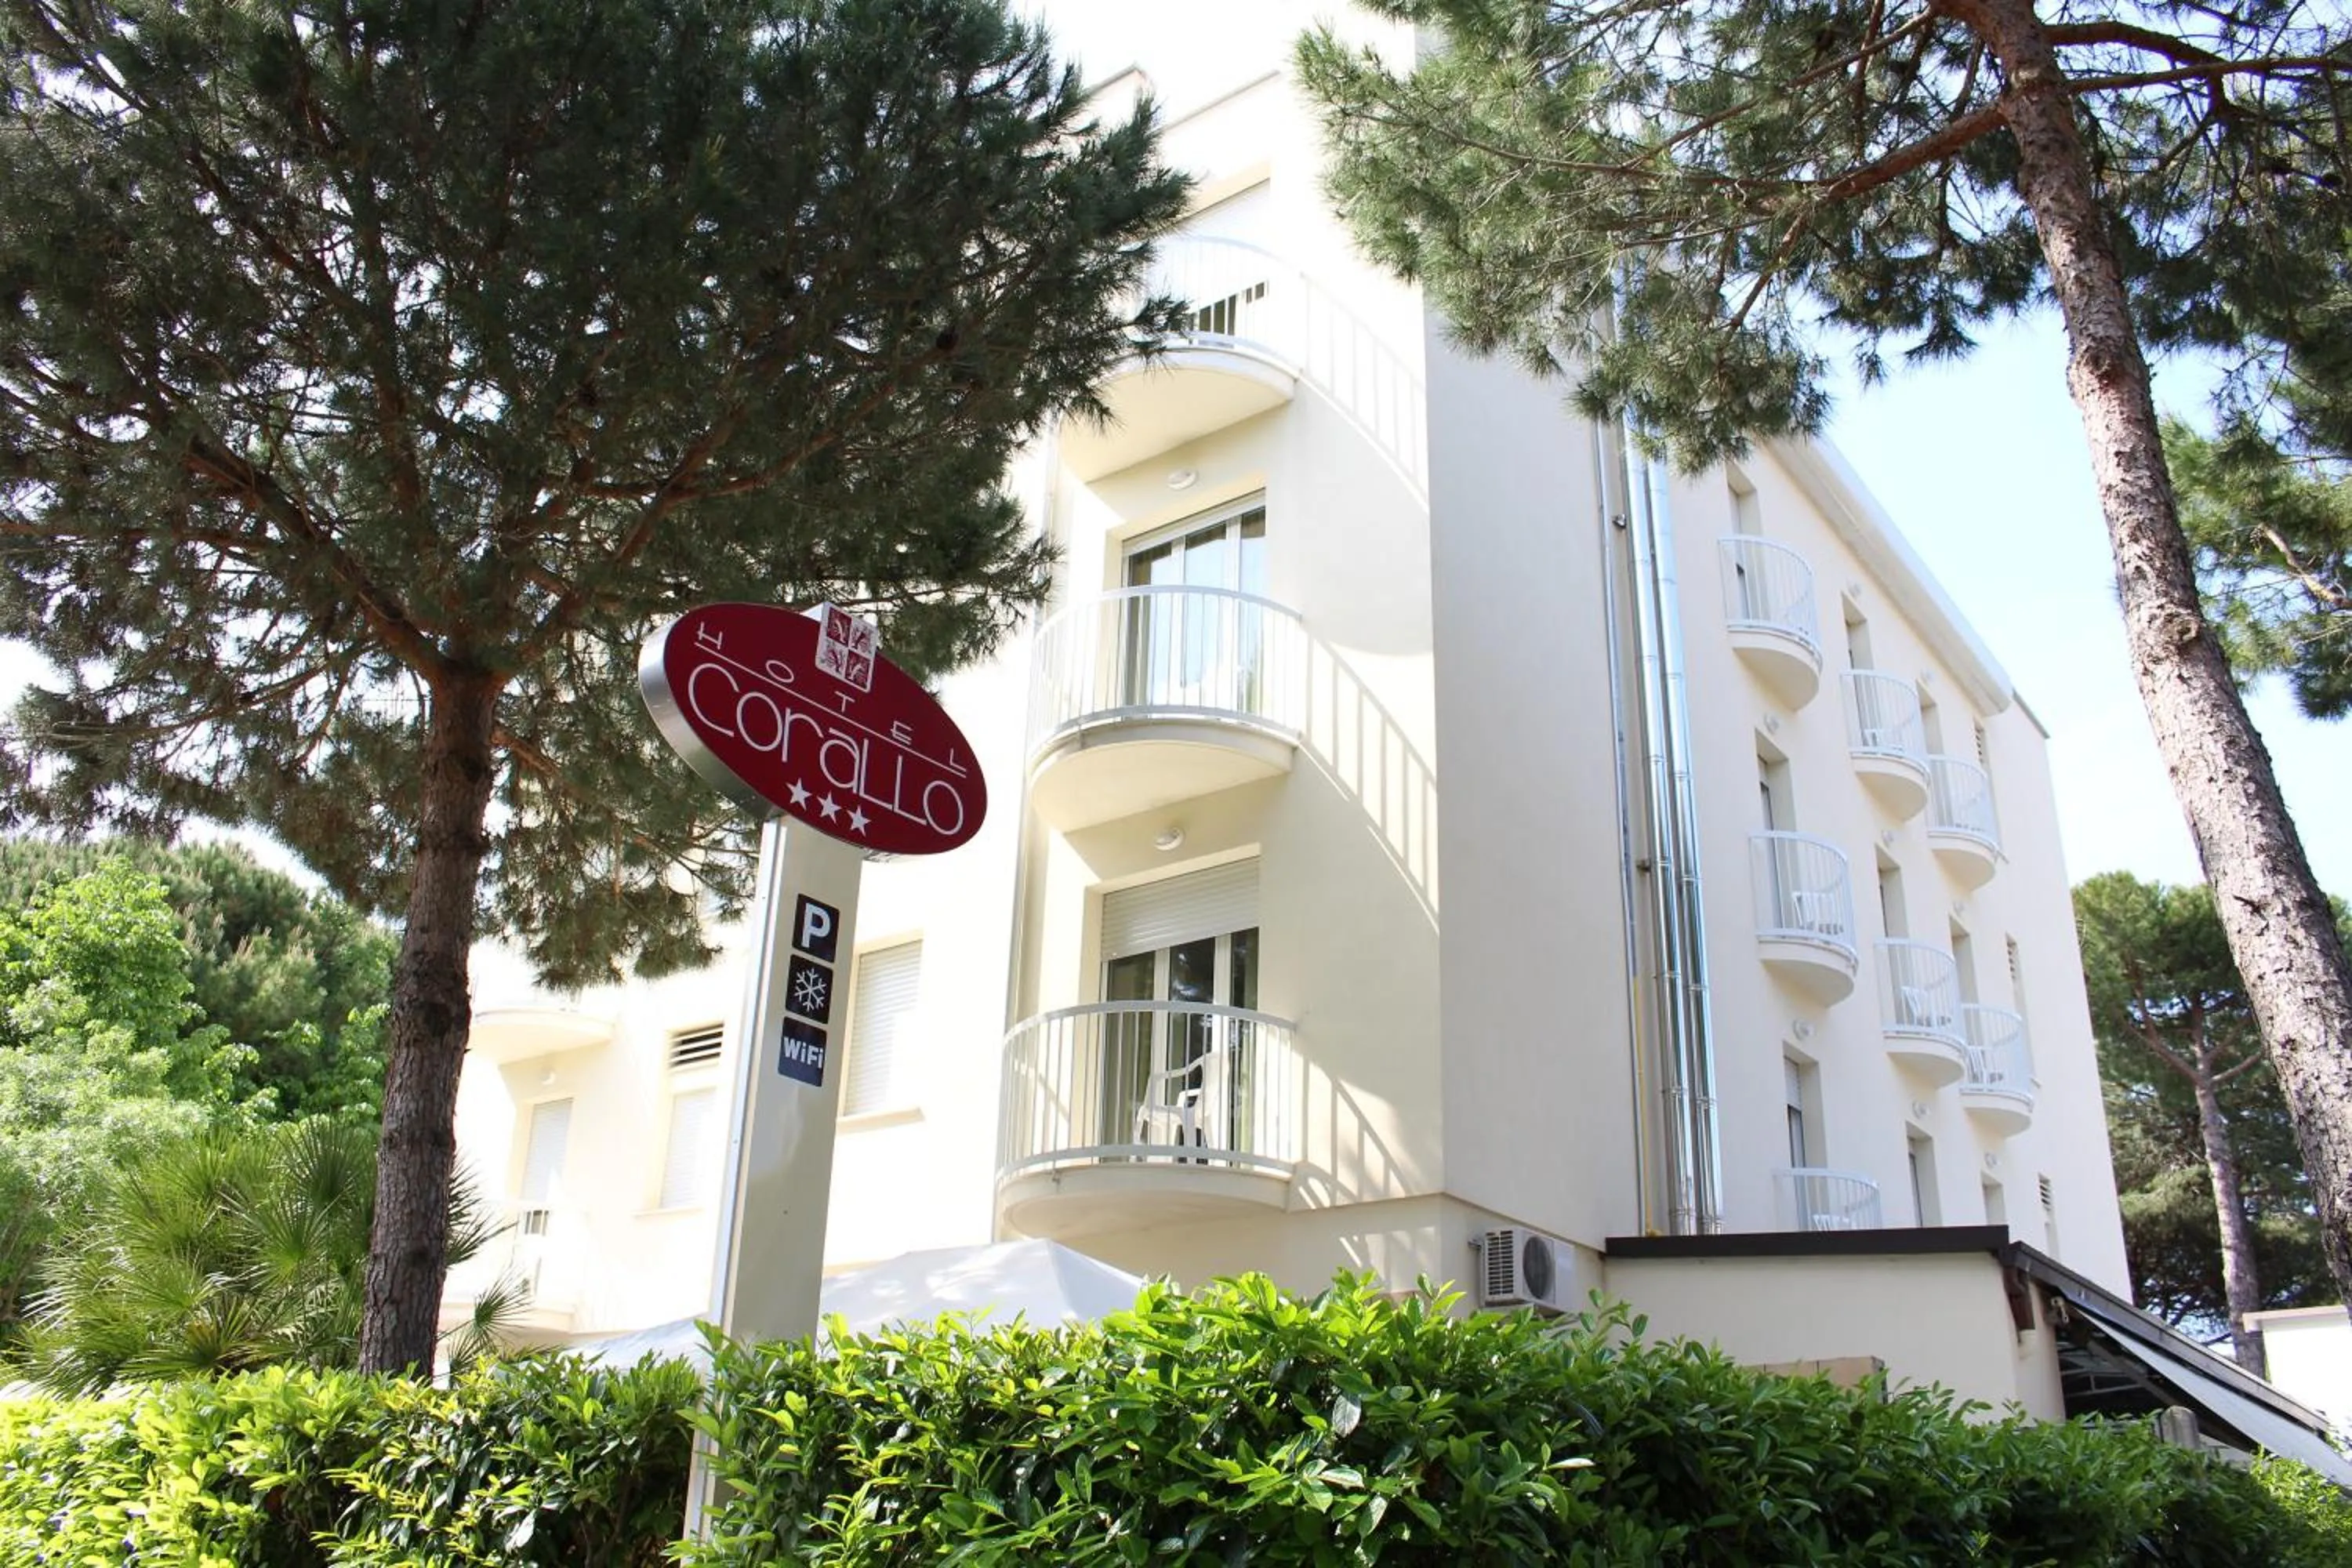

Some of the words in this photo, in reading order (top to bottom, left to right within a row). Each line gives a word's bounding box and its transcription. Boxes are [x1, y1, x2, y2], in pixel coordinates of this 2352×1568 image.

[698, 622, 967, 772] HOTEL
[800, 902, 831, 948] P
[783, 1036, 824, 1069] WiFi
